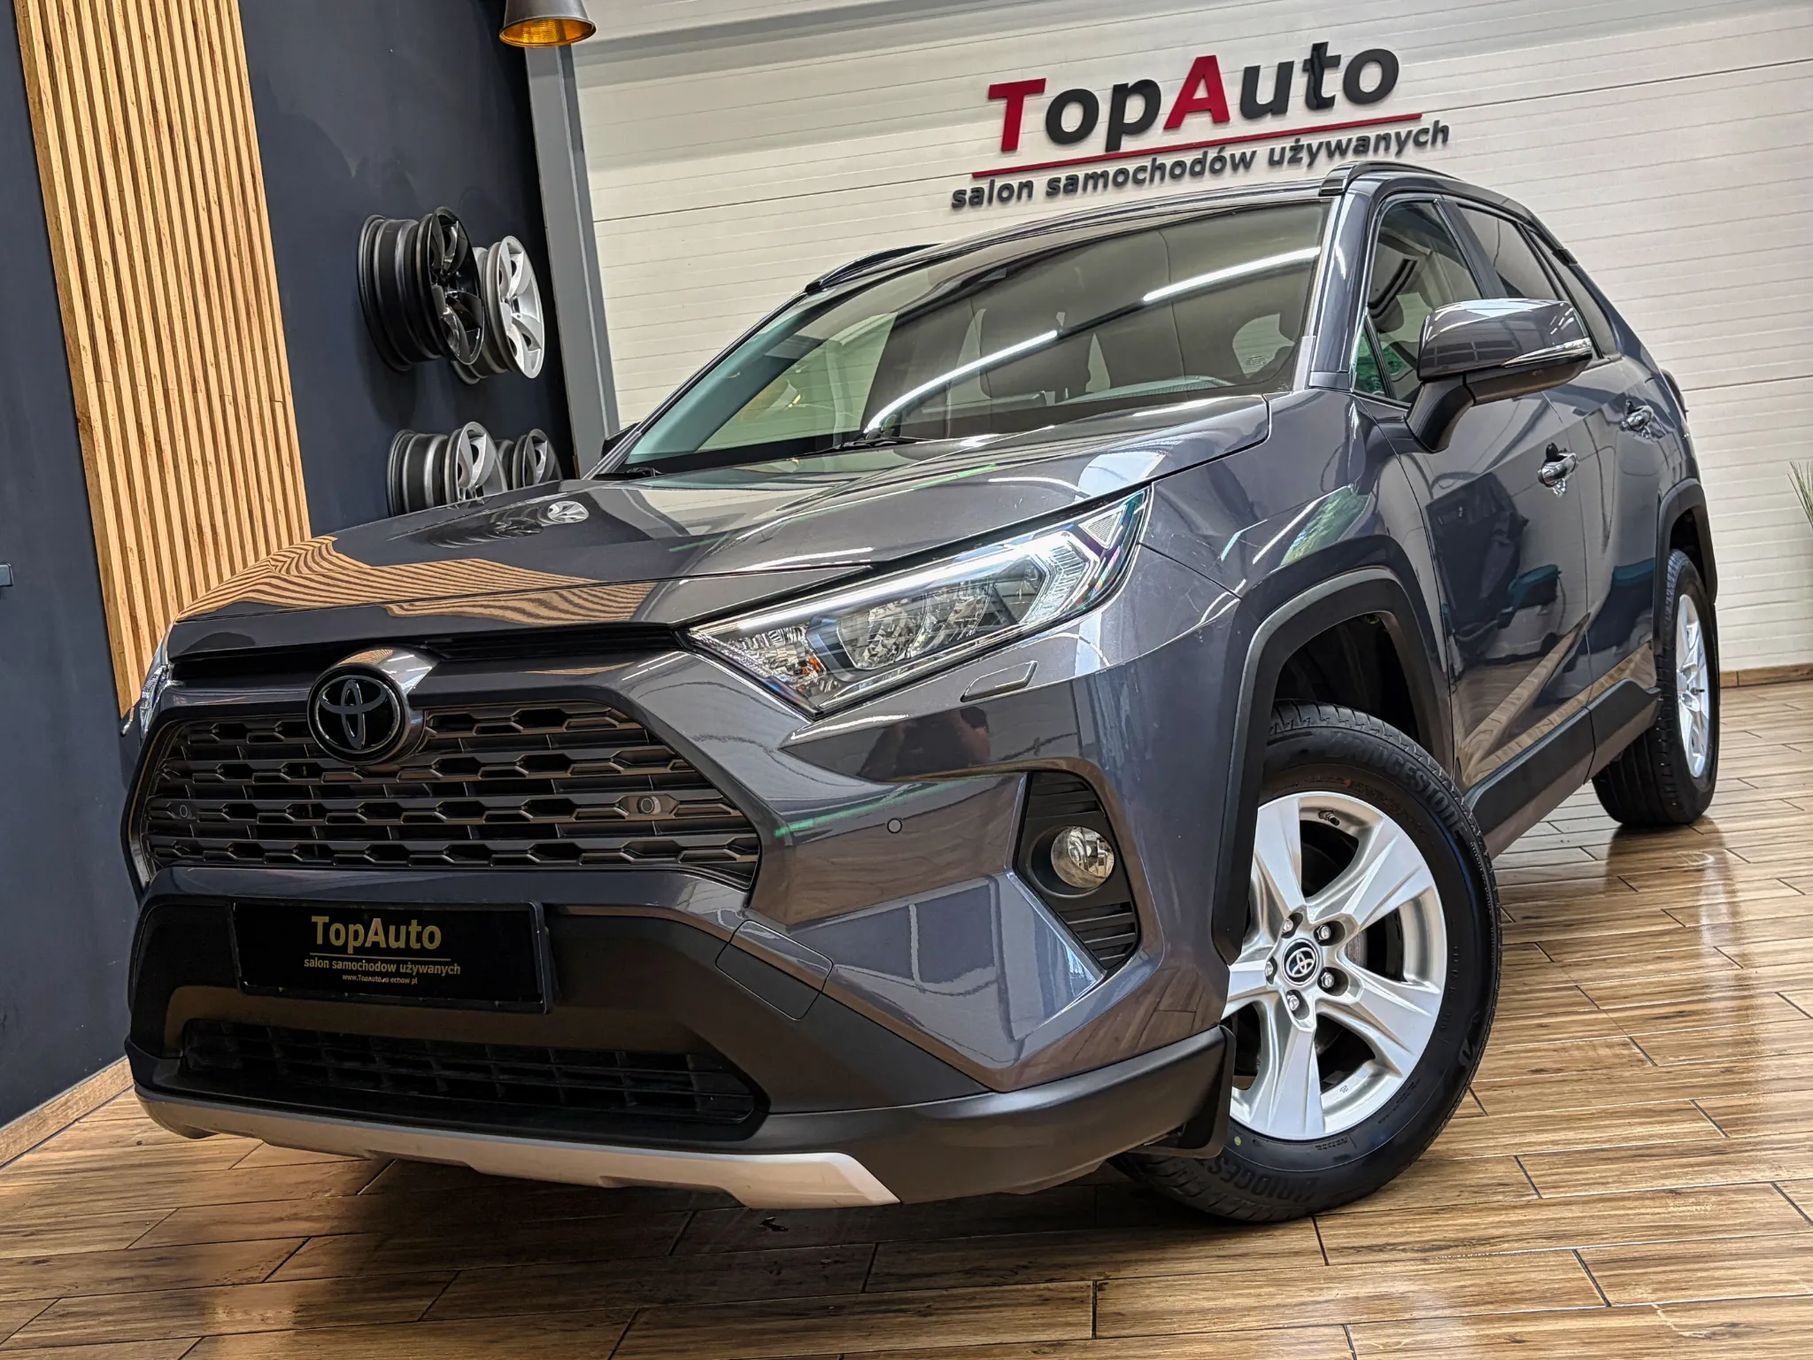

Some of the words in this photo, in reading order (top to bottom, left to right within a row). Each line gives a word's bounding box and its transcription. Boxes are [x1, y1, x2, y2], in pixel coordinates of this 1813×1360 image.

[987, 42, 1400, 153] TopAuto
[951, 178, 1034, 209] salon
[1046, 146, 1257, 198] samochodów
[1268, 119, 1450, 168] używanych
[303, 956, 330, 969] salon
[399, 961, 461, 976] używanych
[311, 915, 442, 954] TopAuto
